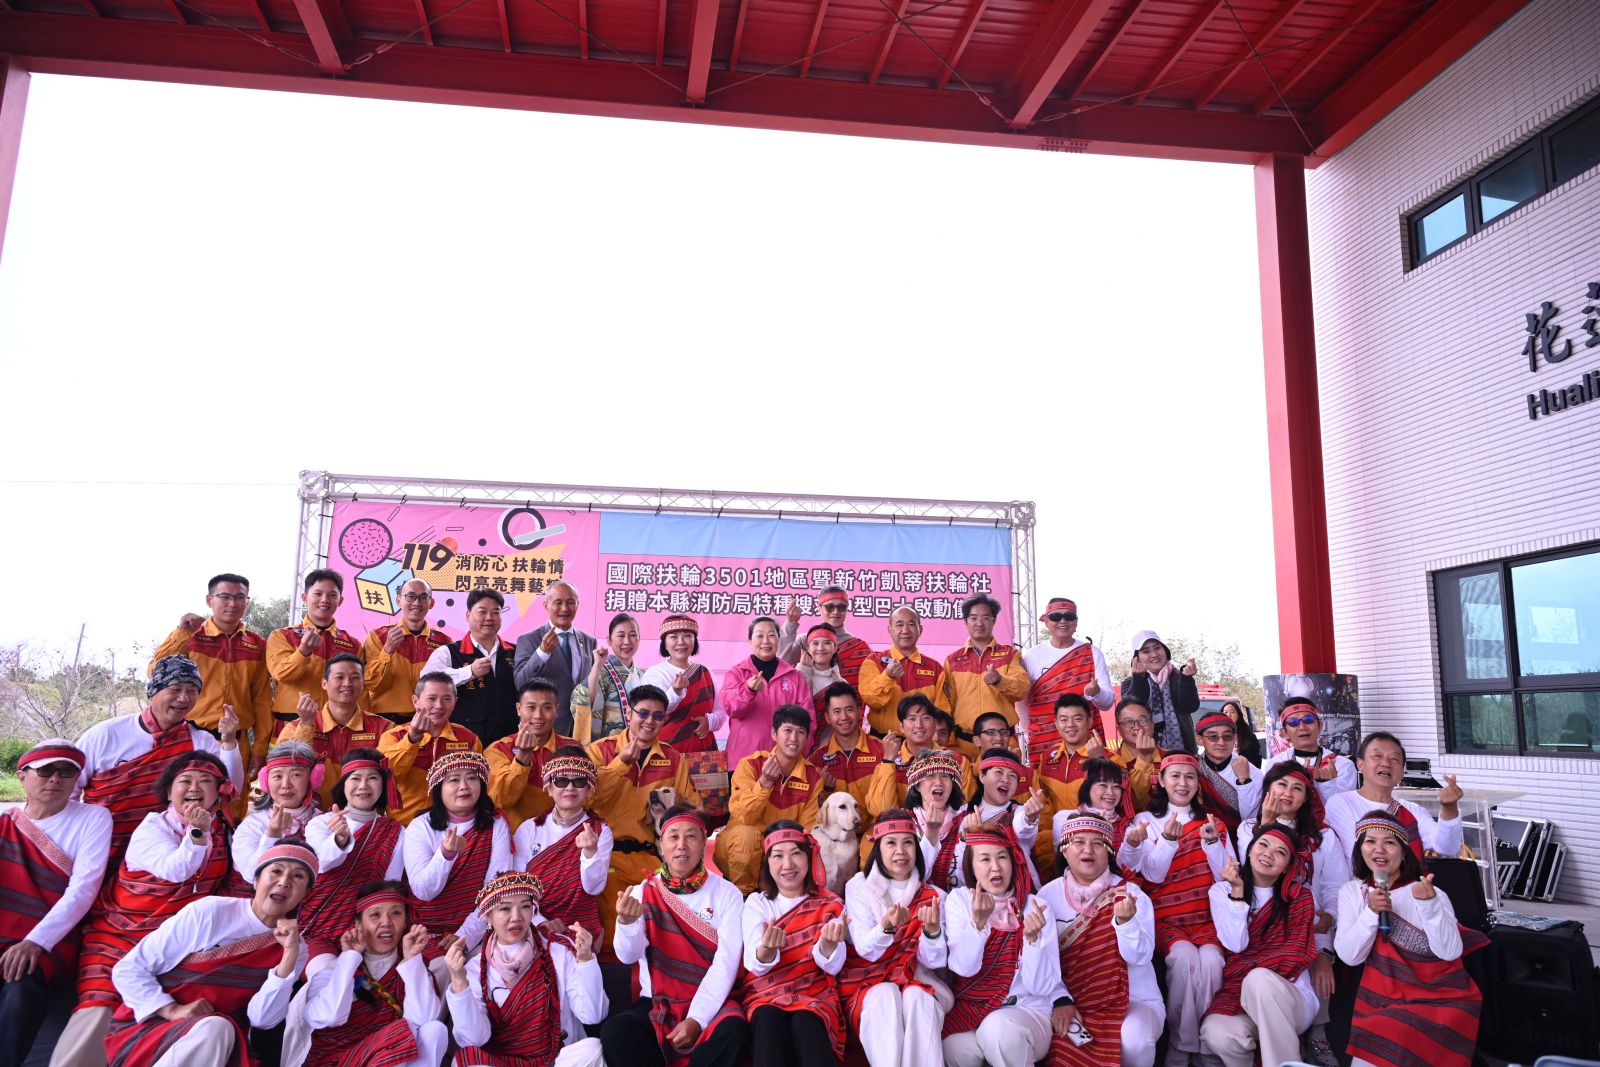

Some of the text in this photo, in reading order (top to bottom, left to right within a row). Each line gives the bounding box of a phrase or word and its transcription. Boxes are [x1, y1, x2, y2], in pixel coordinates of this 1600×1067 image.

[401, 542, 453, 571] 119
[455, 555, 564, 575] 消防心 扶輪情
[607, 562, 991, 594] 國際扶輪3501地區暨新竹凱蒂扶輪社
[364, 589, 385, 606] 扶
